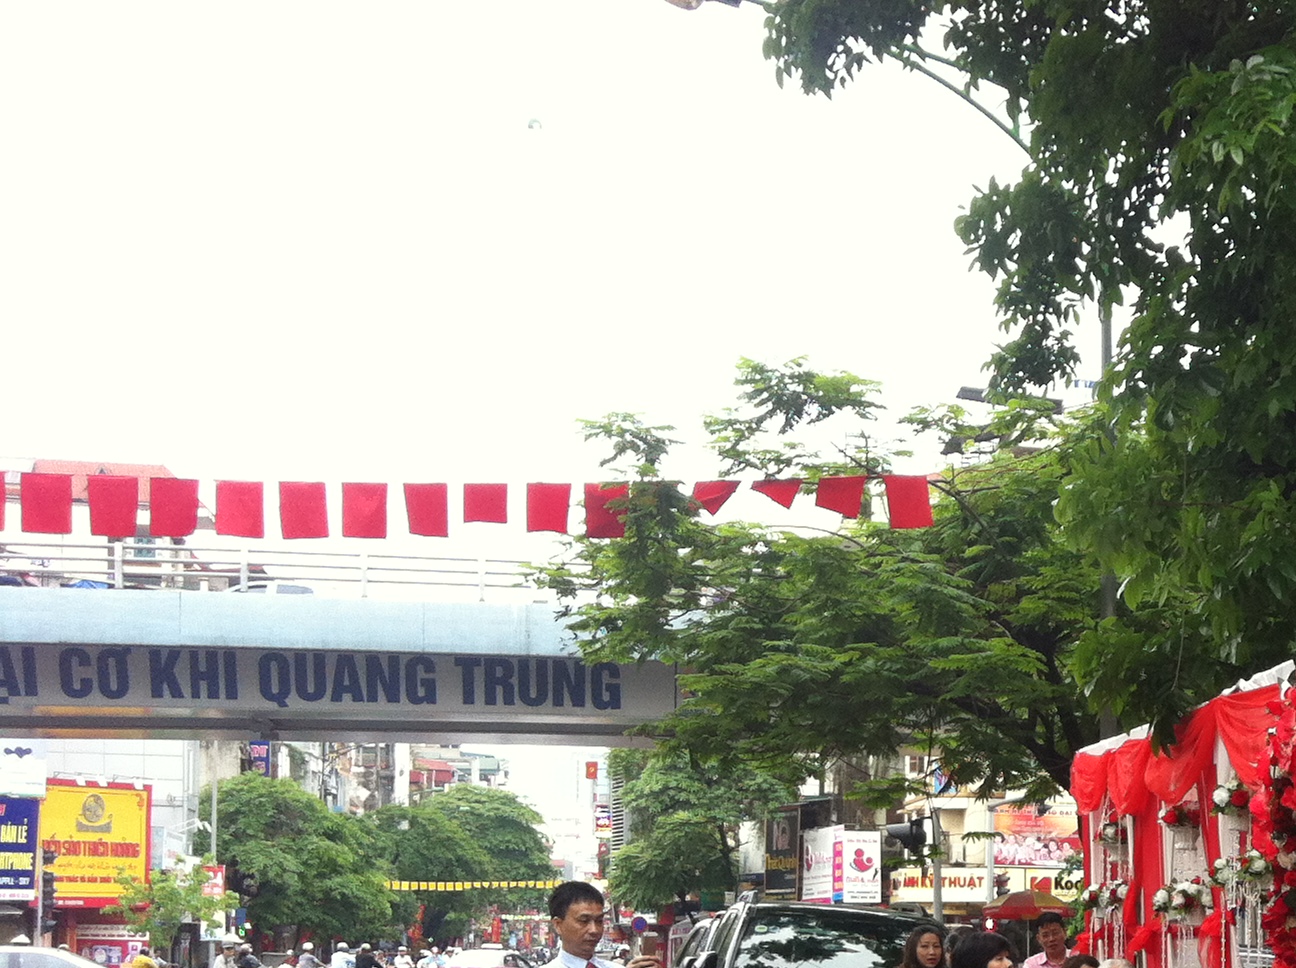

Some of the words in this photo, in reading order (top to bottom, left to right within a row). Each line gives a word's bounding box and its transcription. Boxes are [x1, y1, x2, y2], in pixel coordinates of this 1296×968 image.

[58, 647, 132, 700] CƠ
[258, 651, 437, 708] QUANG
[454, 655, 622, 710] TRUNG
[1054, 877, 1083, 890] Kod
